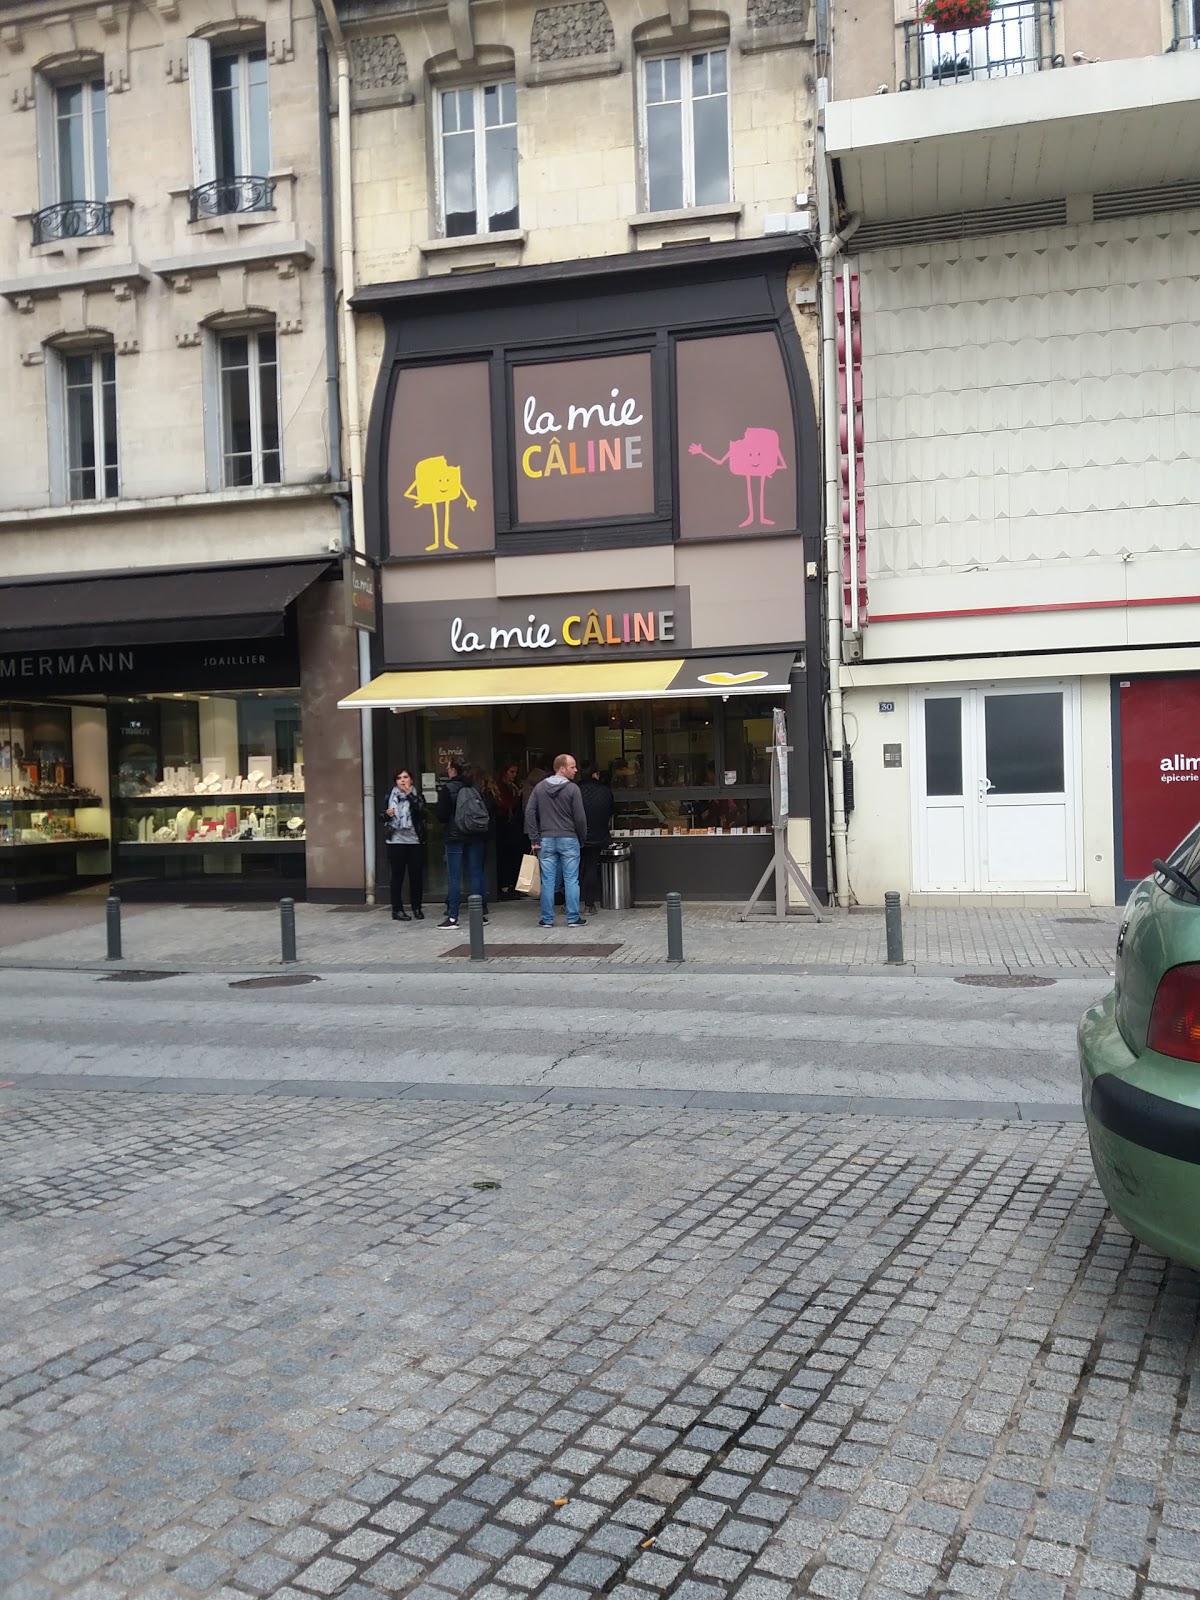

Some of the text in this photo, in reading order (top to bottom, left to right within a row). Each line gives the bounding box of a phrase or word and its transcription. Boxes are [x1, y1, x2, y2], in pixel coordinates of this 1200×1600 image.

[523, 388, 643, 435] la mie
[522, 436, 643, 479] CÂLINE
[450, 608, 675, 653] la mie CÂLINE
[0, 651, 134, 678] MERMANN
[203, 654, 266, 666] JOAILLIER
[881, 703, 893, 711] 30
[1161, 773, 1200, 784] épicerie
